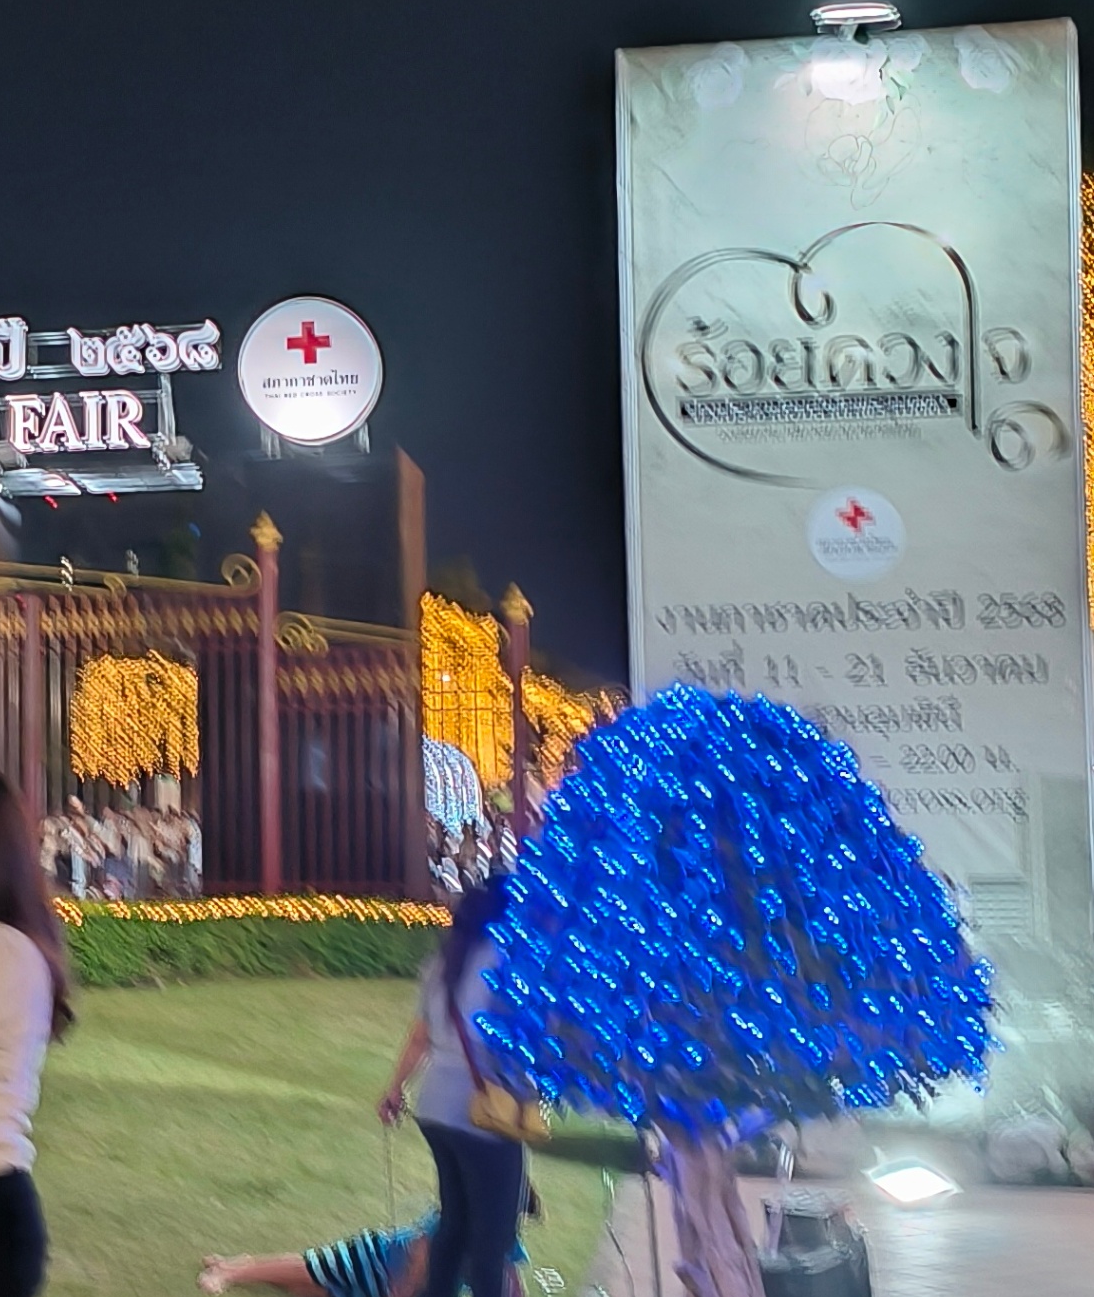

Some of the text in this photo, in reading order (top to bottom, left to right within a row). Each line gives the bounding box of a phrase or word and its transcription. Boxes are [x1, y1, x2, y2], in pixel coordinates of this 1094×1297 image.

[67, 319, 220, 376] ๒๕๖๘
[262, 369, 359, 389] สภากาชาดไทย
[6, 390, 151, 453] FAIR
[657, 588, 966, 633] งานกาชาดประจำปี
